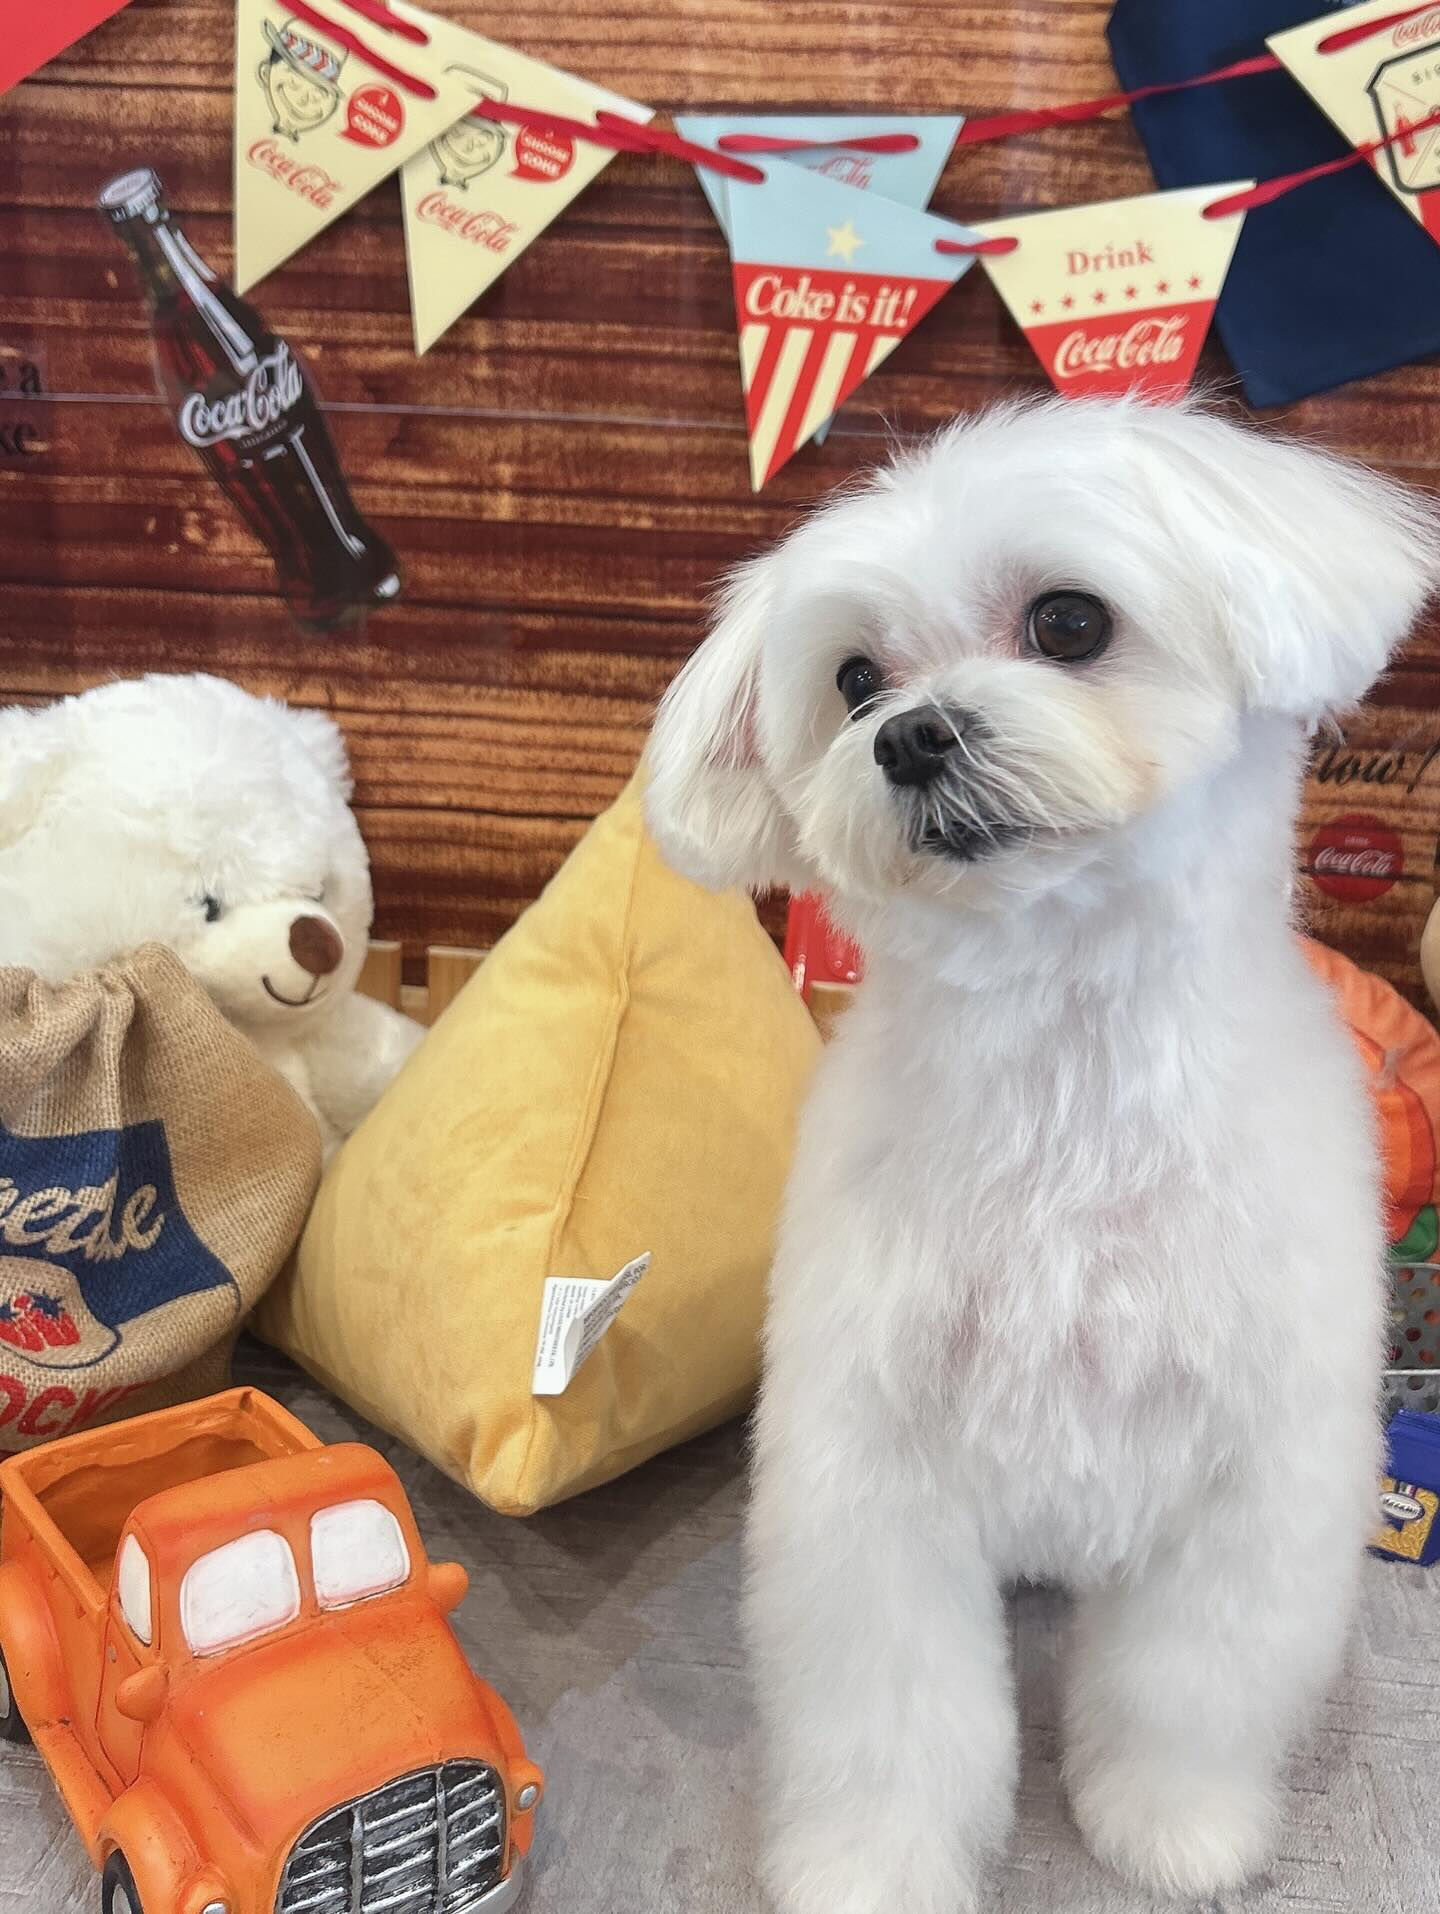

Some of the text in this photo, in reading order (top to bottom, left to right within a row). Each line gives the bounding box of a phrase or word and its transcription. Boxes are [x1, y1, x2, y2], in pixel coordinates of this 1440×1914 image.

[1066, 239, 1154, 275] Drink
[745, 273, 918, 328] Coke is it!
